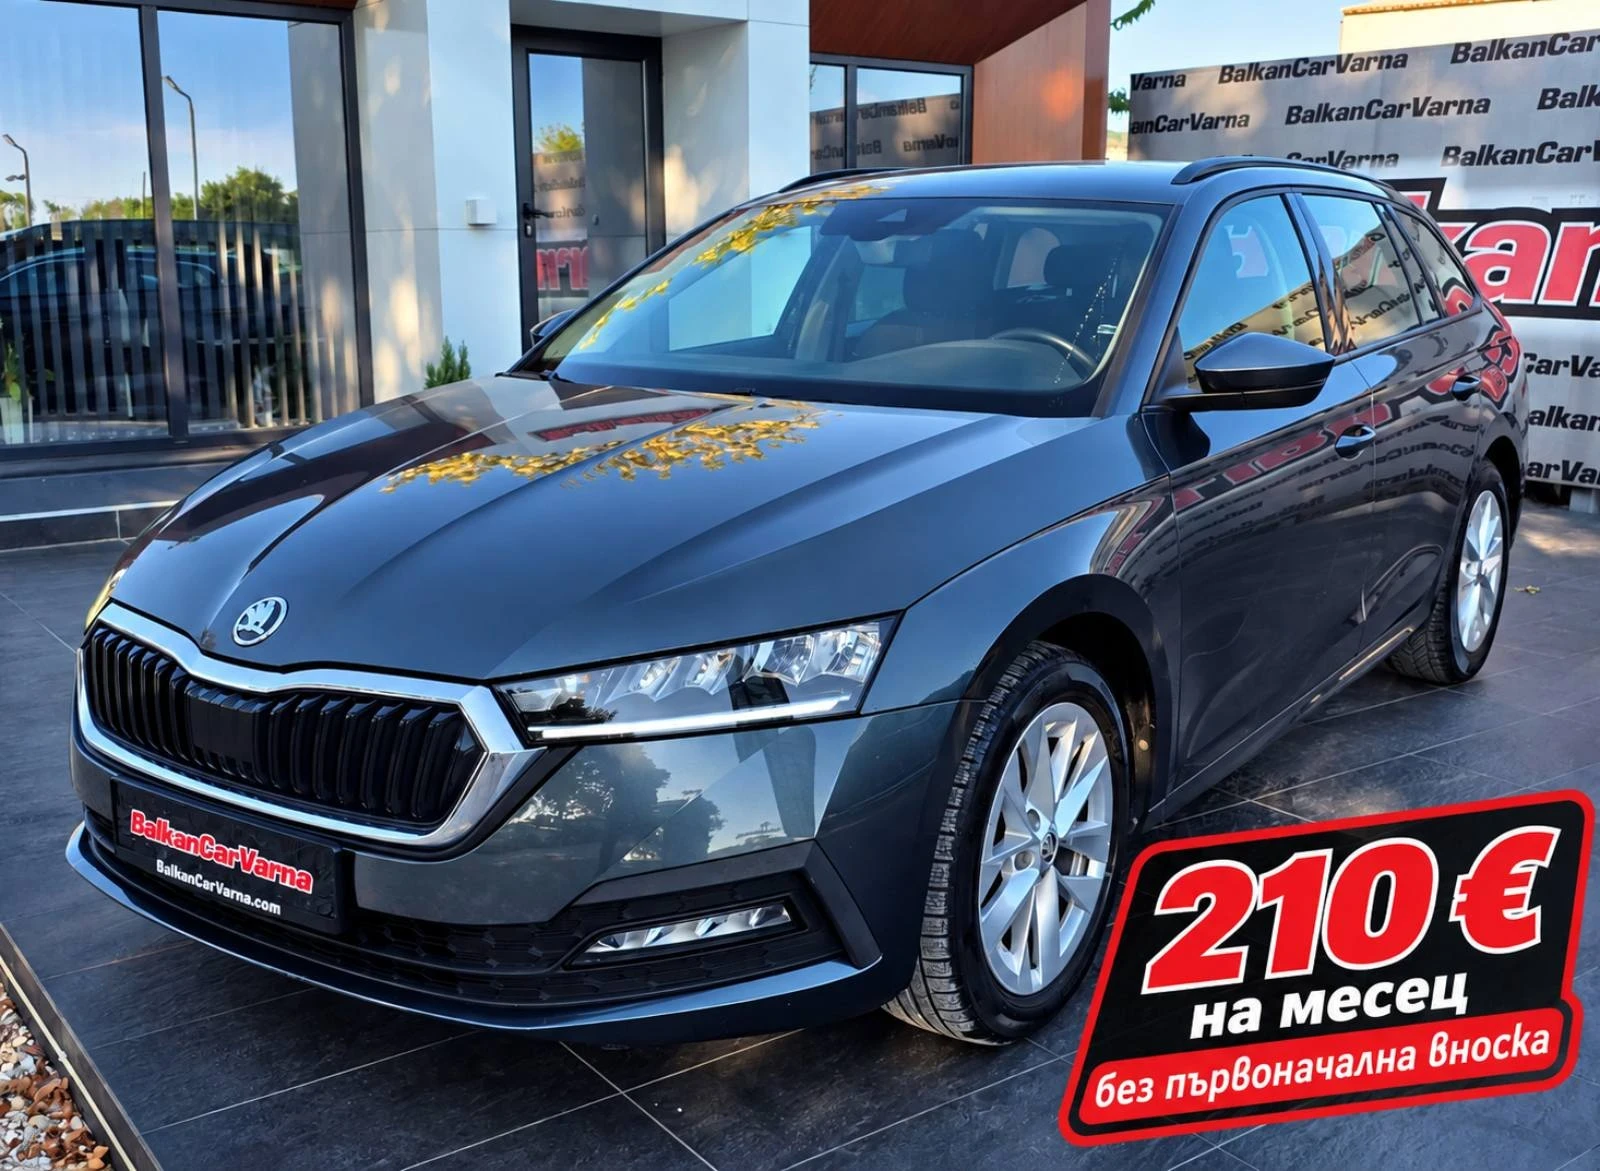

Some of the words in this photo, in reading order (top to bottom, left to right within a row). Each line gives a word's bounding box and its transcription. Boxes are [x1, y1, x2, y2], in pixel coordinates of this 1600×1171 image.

[1130, 74, 1186, 91] Varna
[1218, 53, 1408, 84] BalkanCarVarna
[1285, 96, 1490, 126] BalkanCarVarna
[1526, 459, 1600, 486] arVa
[131, 808, 314, 894] BalkanCarVarna
[156, 859, 281, 916] BalkanCarVarna.com
